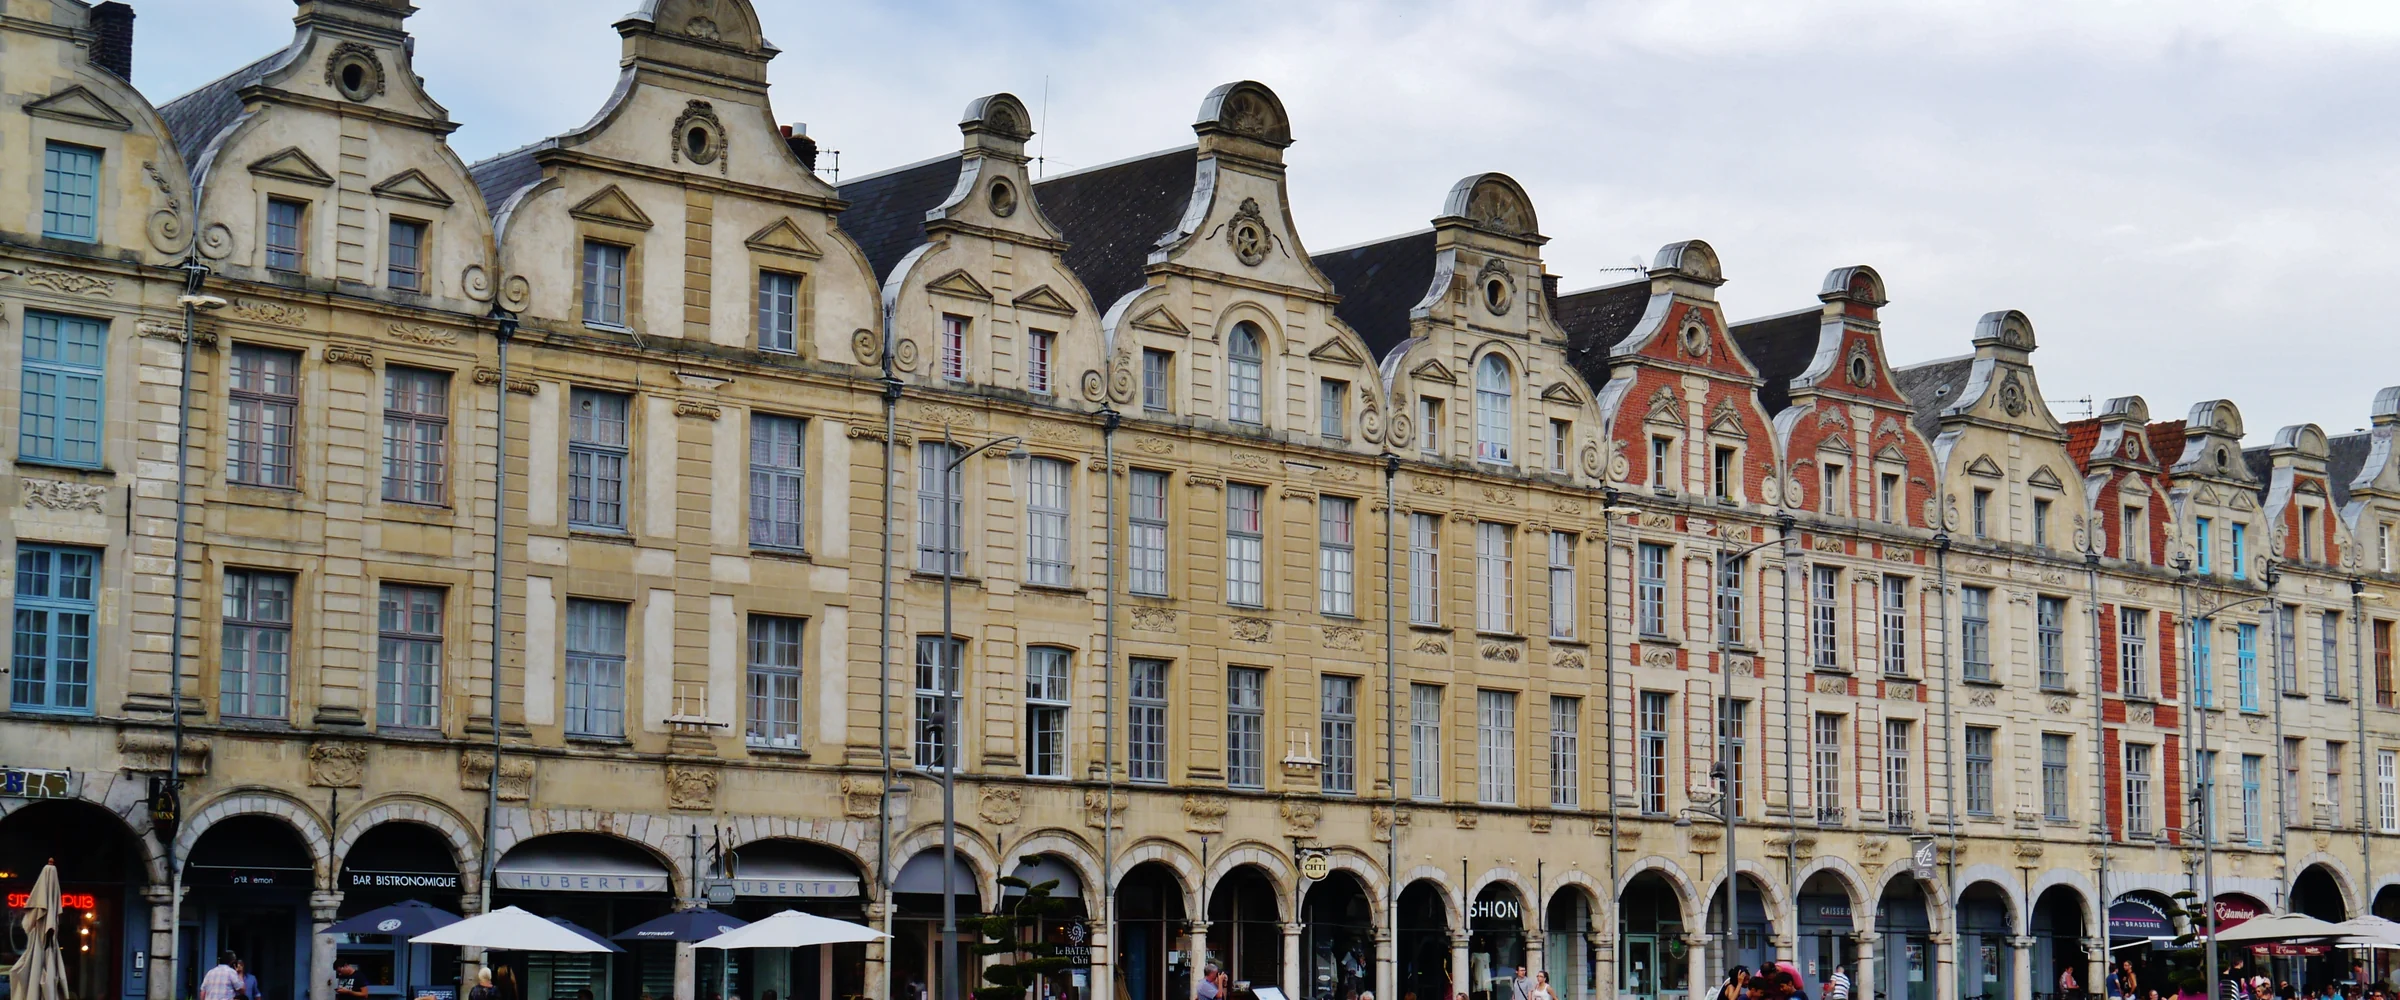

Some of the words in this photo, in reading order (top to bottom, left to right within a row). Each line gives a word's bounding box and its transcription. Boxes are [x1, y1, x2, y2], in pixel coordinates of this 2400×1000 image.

[353, 875, 371, 885] BAR
[376, 876, 456, 887] BISTRONOMIQUE
[521, 875, 626, 888] HUBERT
[742, 882, 820, 894] UBERT
[61, 894, 94, 909] PUB
[1470, 901, 1517, 918] SHION
[1821, 907, 1844, 916] CAISSE
[2125, 921, 2160, 929] BRASSERIE
[1055, 947, 1063, 955] Le
